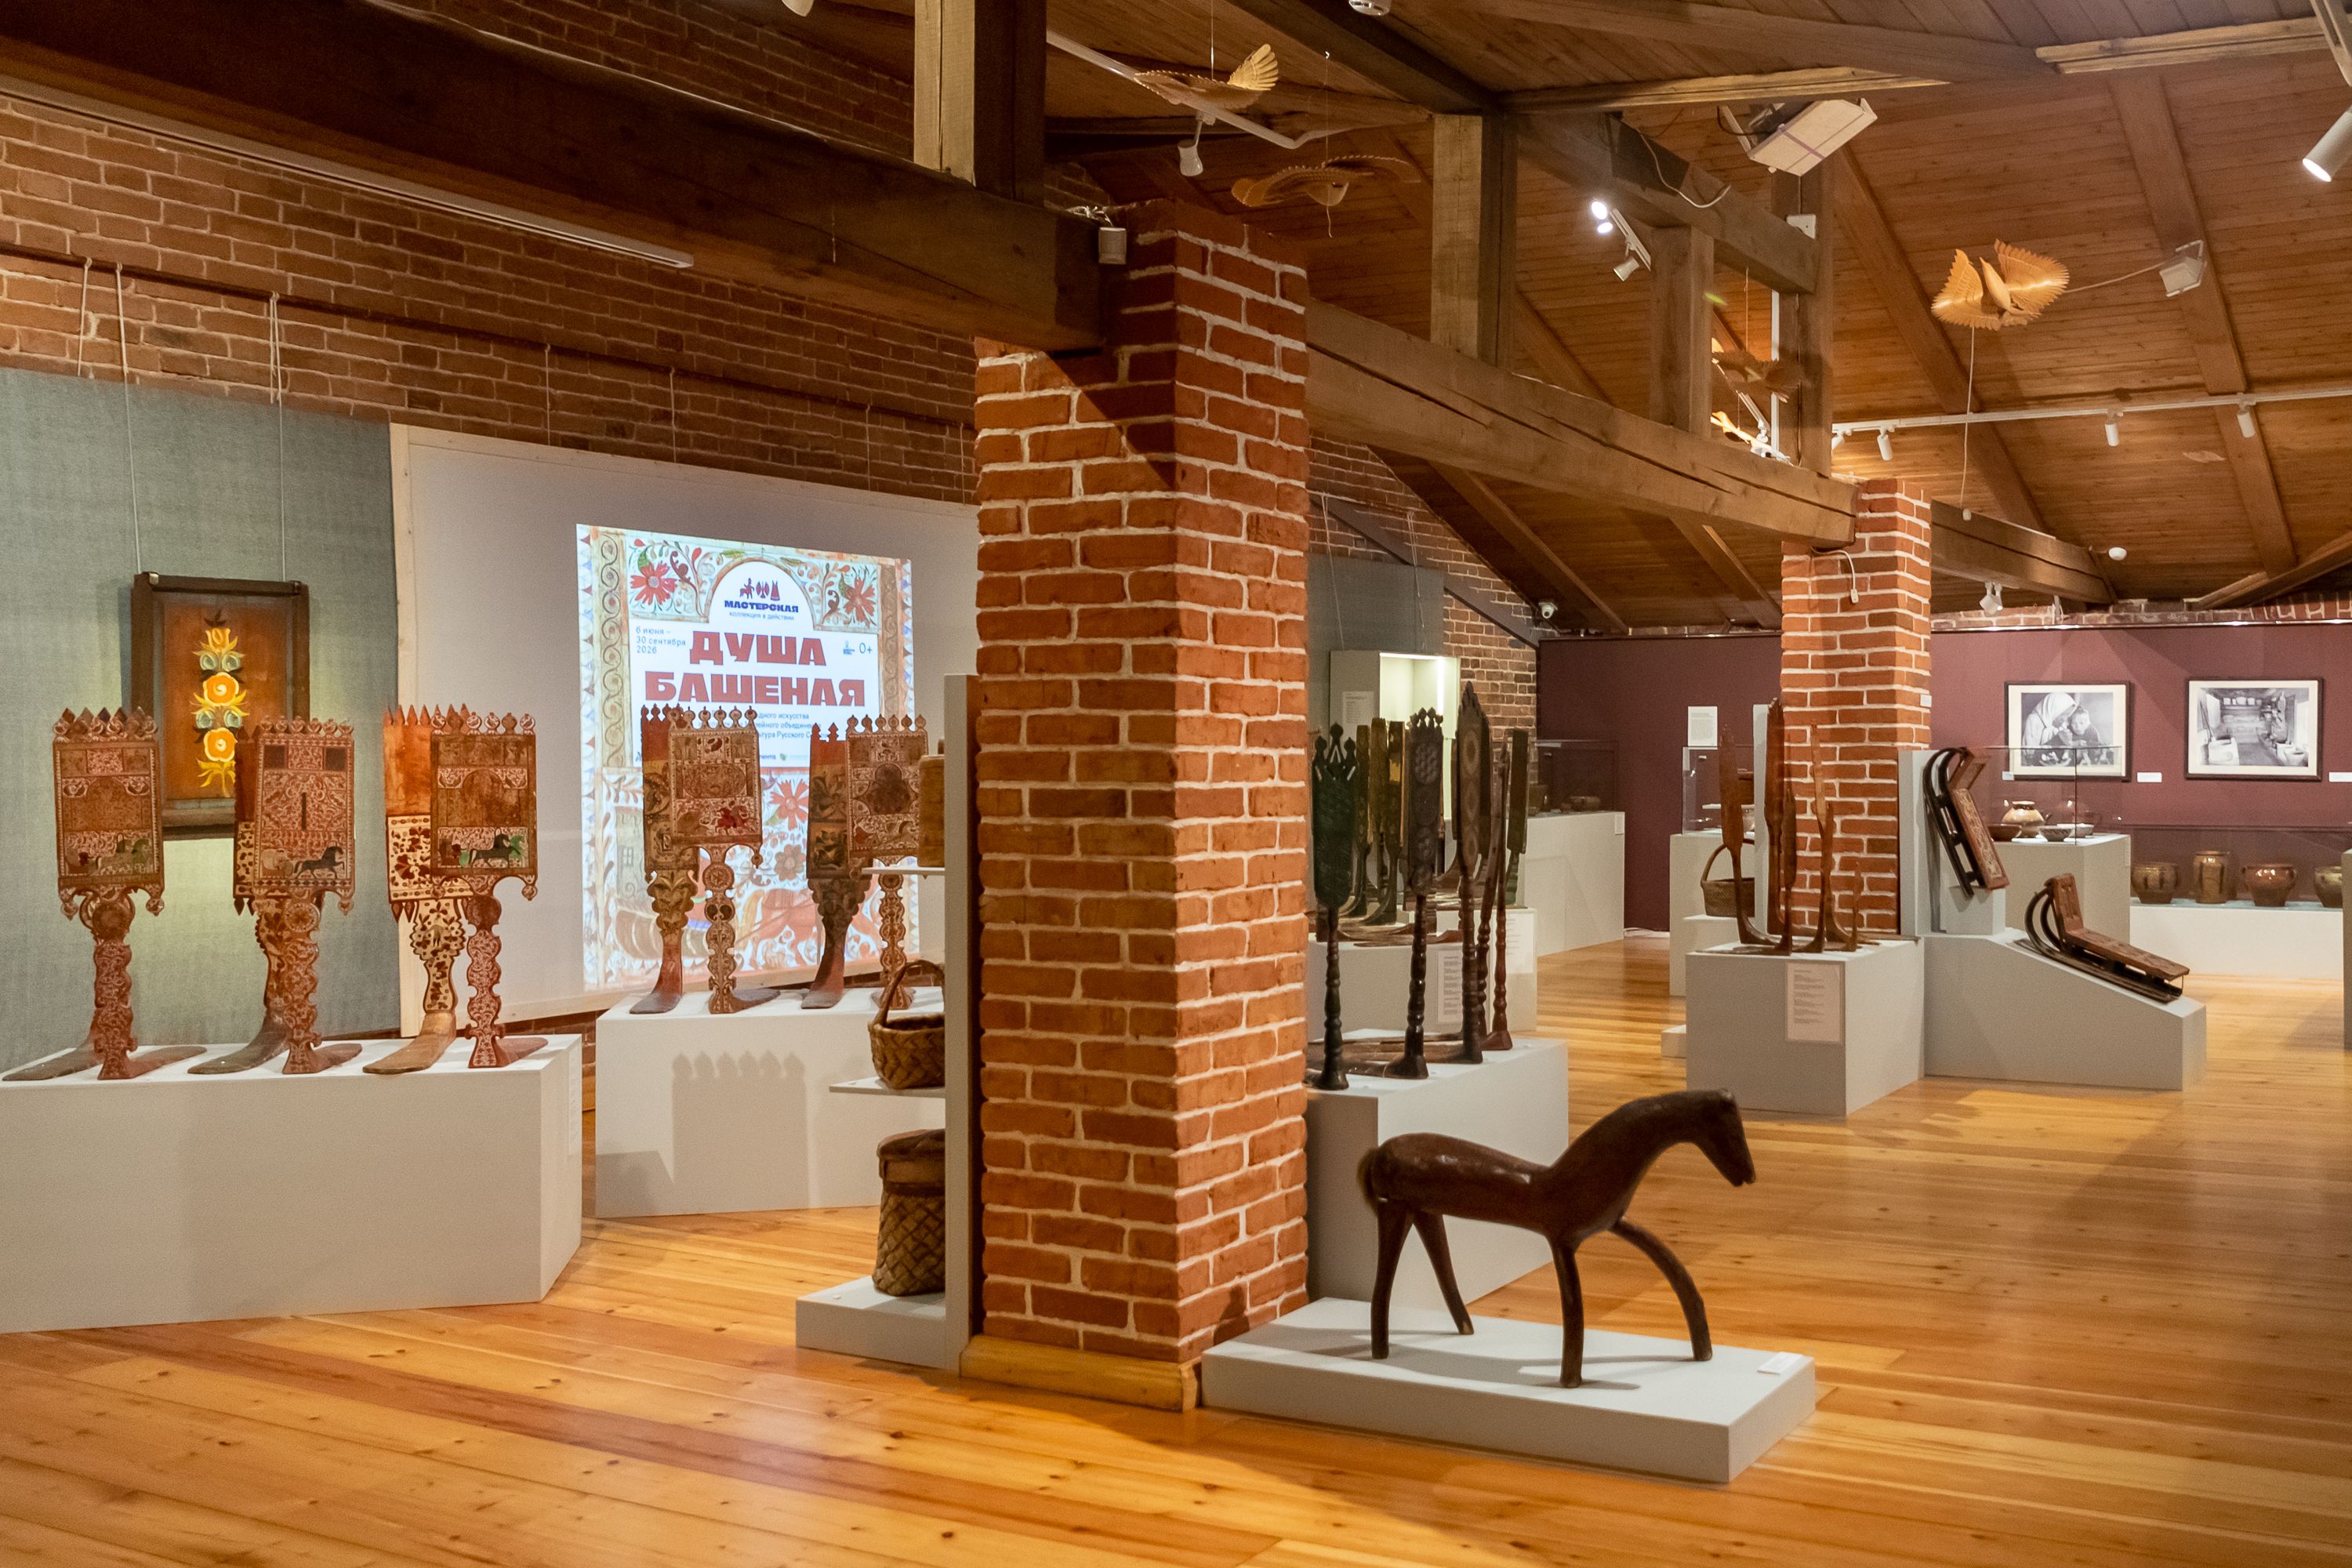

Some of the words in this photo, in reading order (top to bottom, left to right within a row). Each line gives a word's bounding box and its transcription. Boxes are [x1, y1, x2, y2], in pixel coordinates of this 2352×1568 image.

[724, 600, 799, 613] МАСТЕРСКАЯ
[636, 626, 641, 634] 6
[636, 635, 647, 644] 30
[648, 637, 686, 648] сентября
[689, 630, 827, 666] ДУША
[636, 645, 657, 654] 2026
[858, 642, 873, 655] 0+
[644, 670, 866, 707] БАШЕНАЯ
[777, 731, 804, 740] Русского
